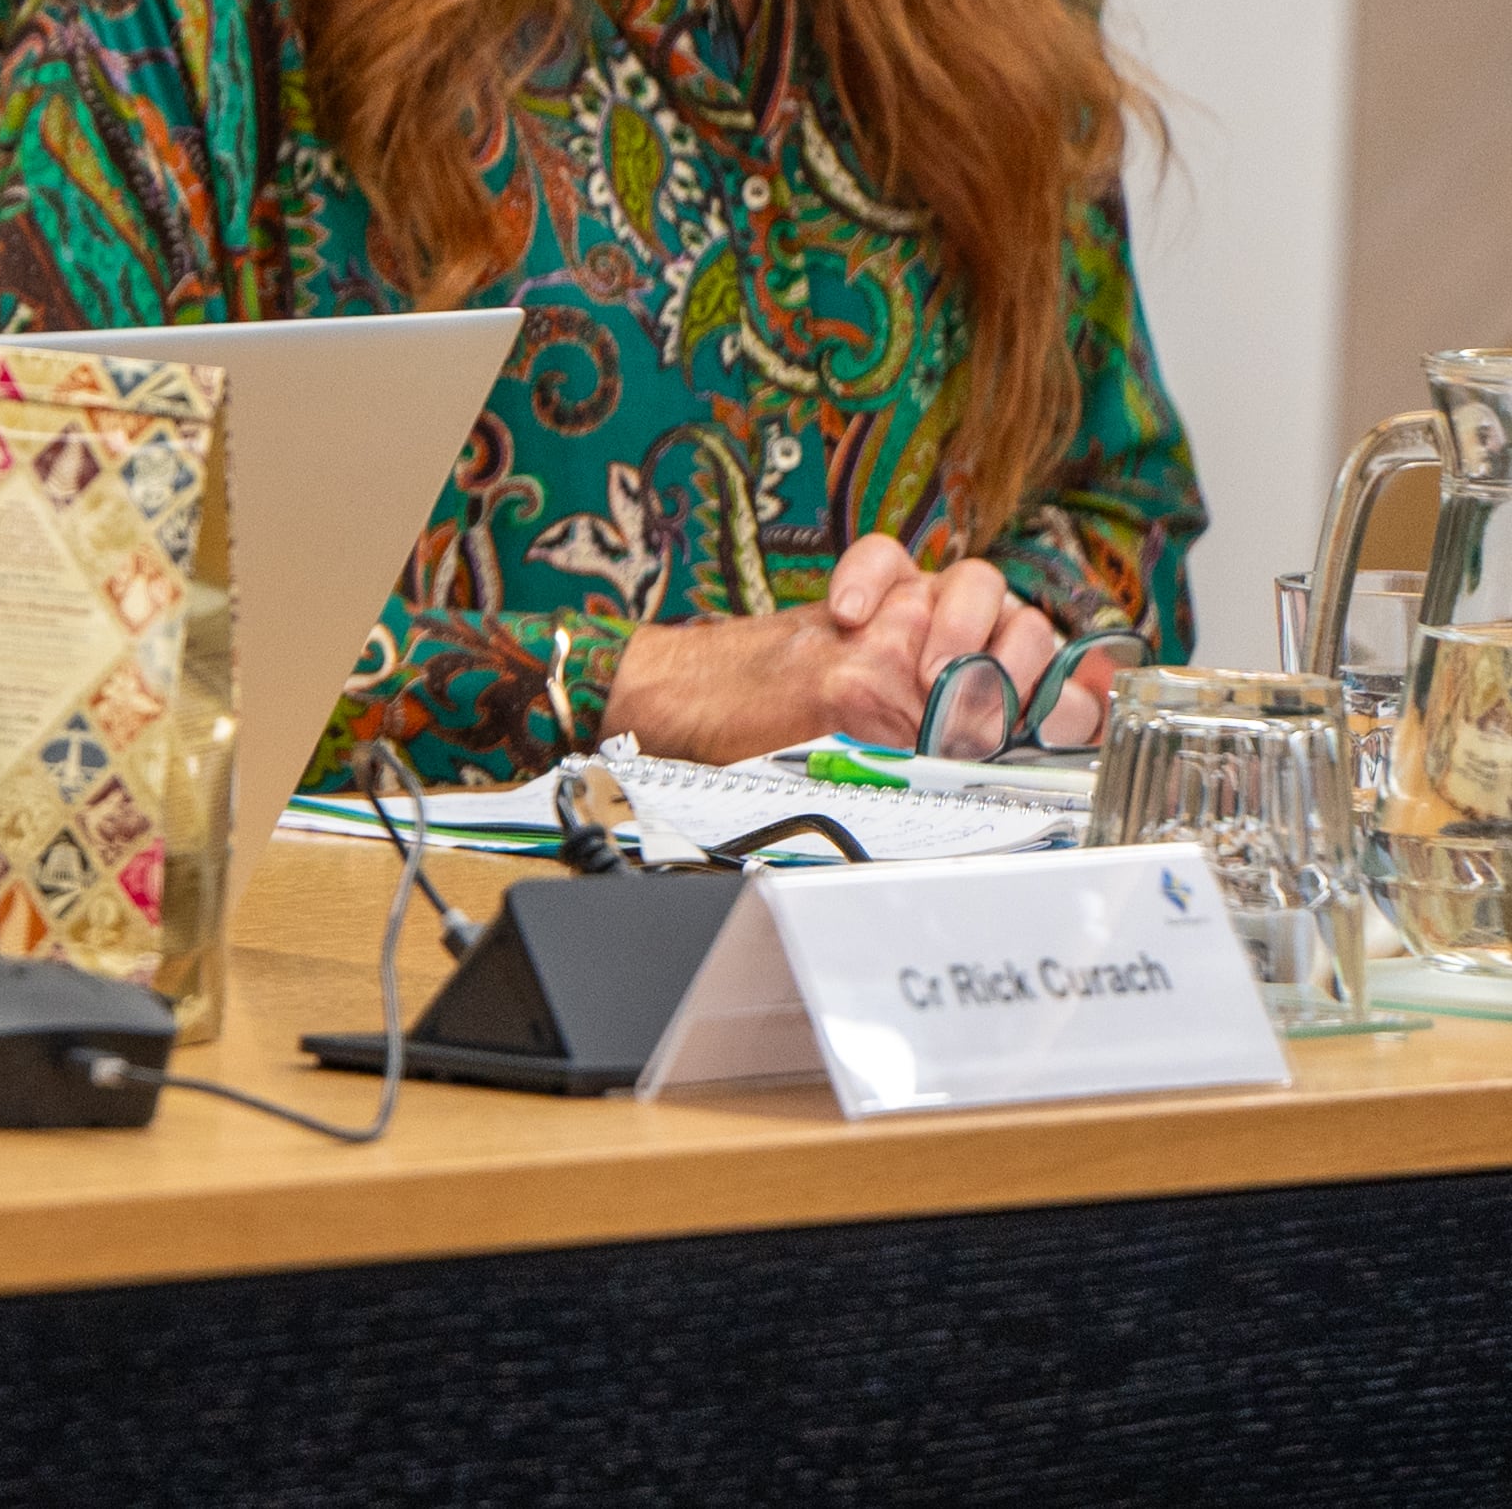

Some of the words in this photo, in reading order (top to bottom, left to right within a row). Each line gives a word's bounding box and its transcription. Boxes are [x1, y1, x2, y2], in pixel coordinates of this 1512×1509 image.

[898, 967, 943, 1009] Cr
[948, 960, 1035, 1005] Rick
[1039, 951, 1172, 998] Curach
